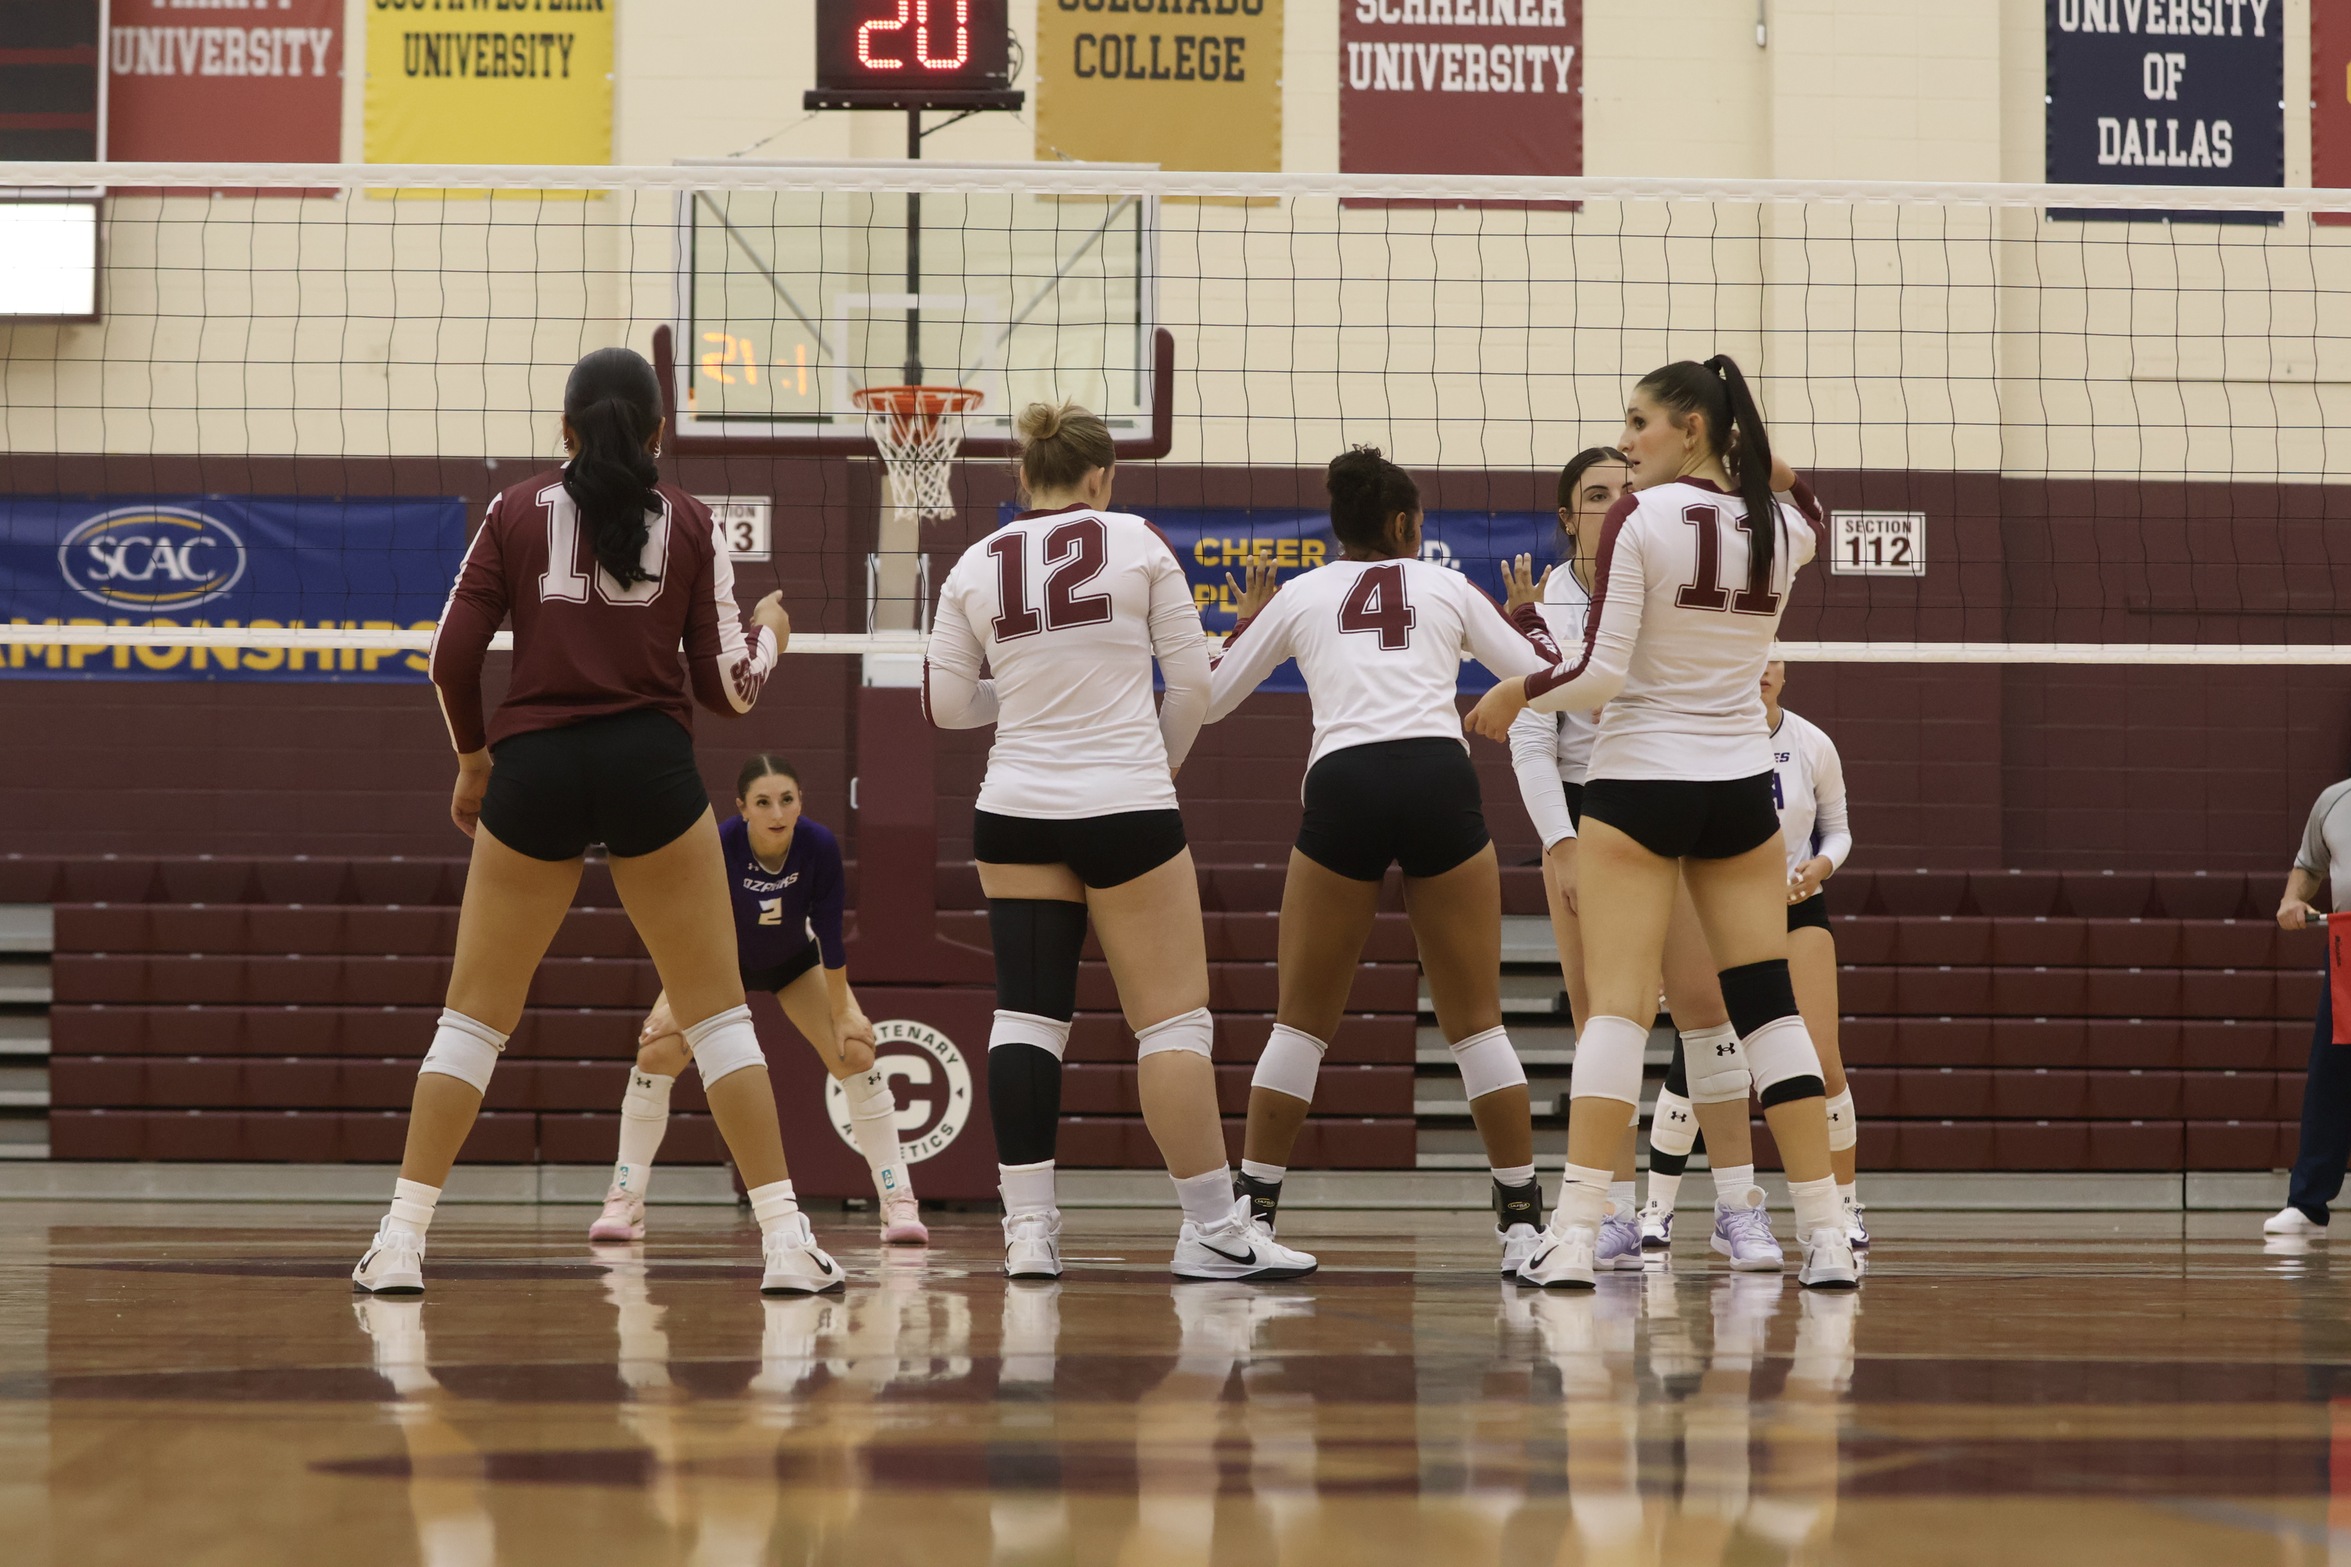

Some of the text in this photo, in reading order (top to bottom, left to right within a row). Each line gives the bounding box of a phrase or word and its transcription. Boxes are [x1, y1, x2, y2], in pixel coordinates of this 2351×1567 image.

[858, 0, 968, 69] 20
[2059, 0, 2269, 37] UNIVERSITY
[111, 27, 333, 76] UNIVERSITY
[404, 32, 575, 78] UNIVERSITY
[1074, 33, 1246, 82] COLLEGE
[1347, 42, 1575, 93] UNIVERSITY
[2143, 53, 2187, 100] OF
[2098, 117, 2233, 168] DALLAS
[1845, 519, 1912, 534] SECTION
[87, 535, 217, 582] SCAC
[1193, 537, 1327, 568] CHEER
[1675, 503, 1782, 616] 11
[1845, 536, 1911, 566] 112
[987, 516, 1113, 643] 12
[1337, 563, 1416, 651] 4
[0, 617, 438, 672] MPIONSHIP
[758, 897, 782, 925] 2
[873, 1024, 960, 1065] TENARY
